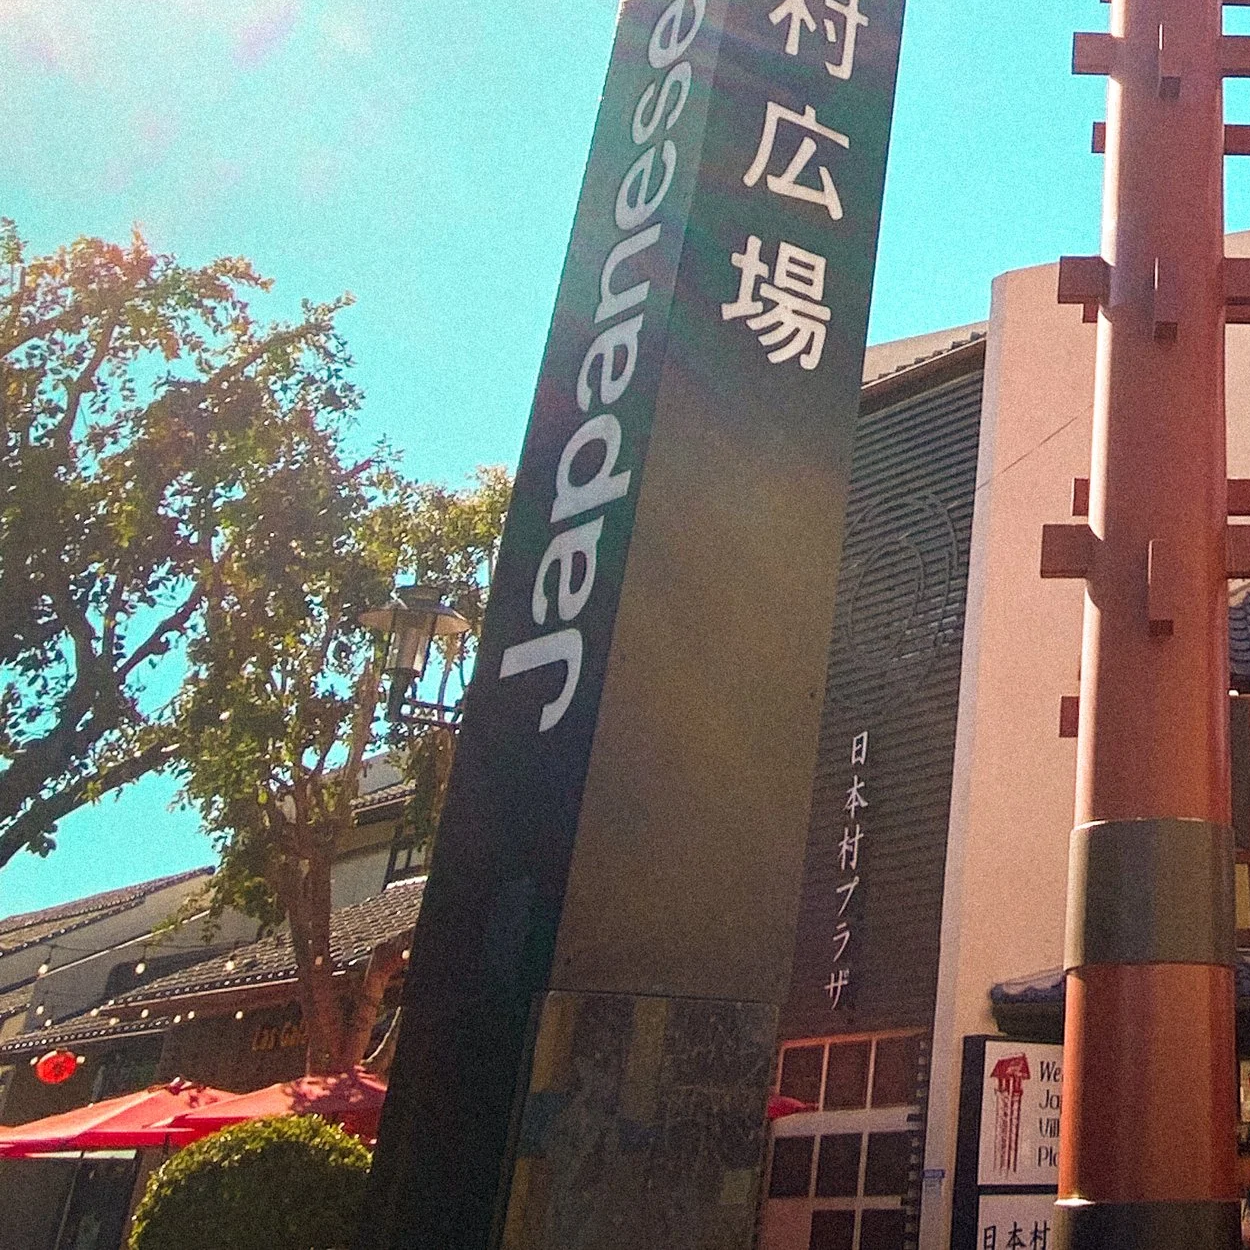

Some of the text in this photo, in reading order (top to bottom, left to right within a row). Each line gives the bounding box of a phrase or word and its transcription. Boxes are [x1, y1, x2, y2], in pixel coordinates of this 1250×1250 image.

[824, 731, 868, 1010] 日本村プラザ
[1039, 1060, 1064, 1083] We
